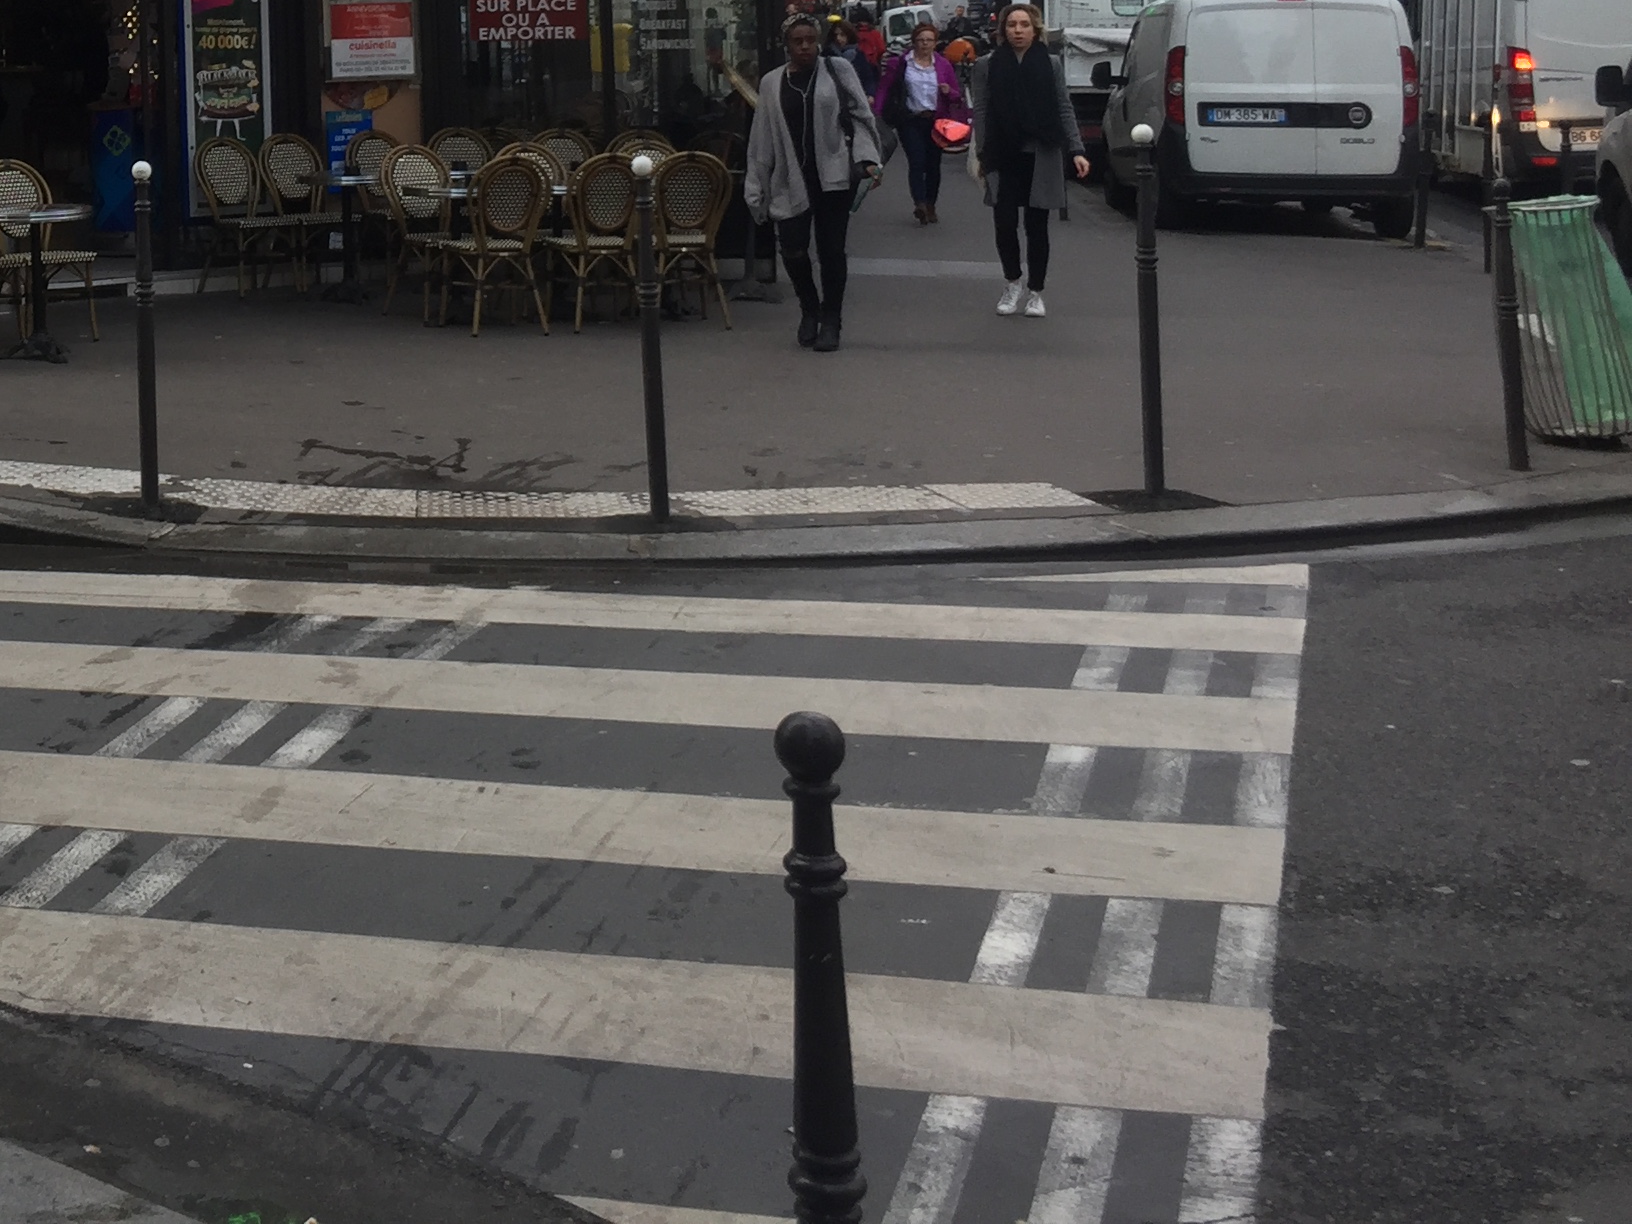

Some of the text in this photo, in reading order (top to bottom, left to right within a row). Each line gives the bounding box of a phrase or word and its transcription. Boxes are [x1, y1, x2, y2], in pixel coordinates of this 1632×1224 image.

[476, 0, 510, 13] SUR
[501, 13, 551, 27] OU A
[478, 26, 576, 41] EMPORTER
[198, 34, 216, 49] 40
